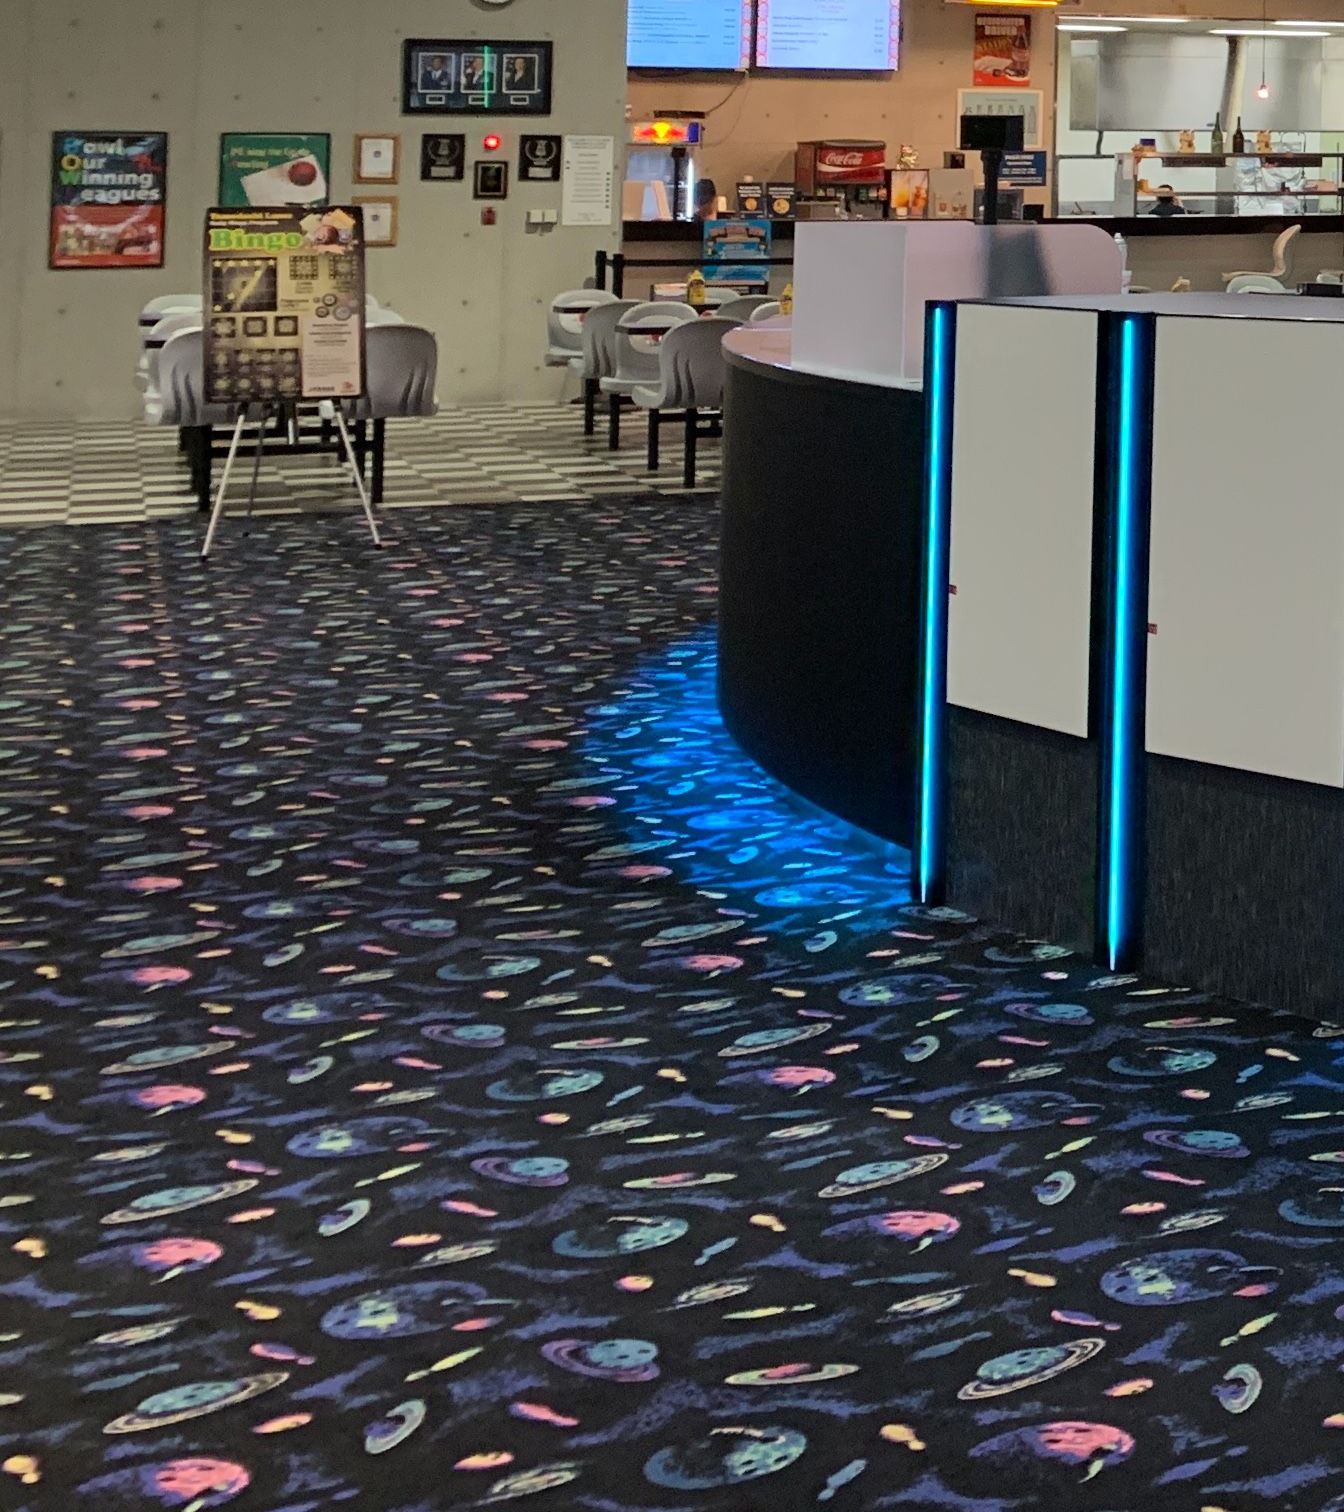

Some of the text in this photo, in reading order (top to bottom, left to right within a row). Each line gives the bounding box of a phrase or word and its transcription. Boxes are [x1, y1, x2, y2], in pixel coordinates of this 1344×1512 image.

[63, 137, 124, 156] Bowl
[61, 154, 107, 171] Our
[60, 170, 153, 188] Winning
[63, 188, 160, 204] eagues
[209, 228, 303, 253] Bingo
